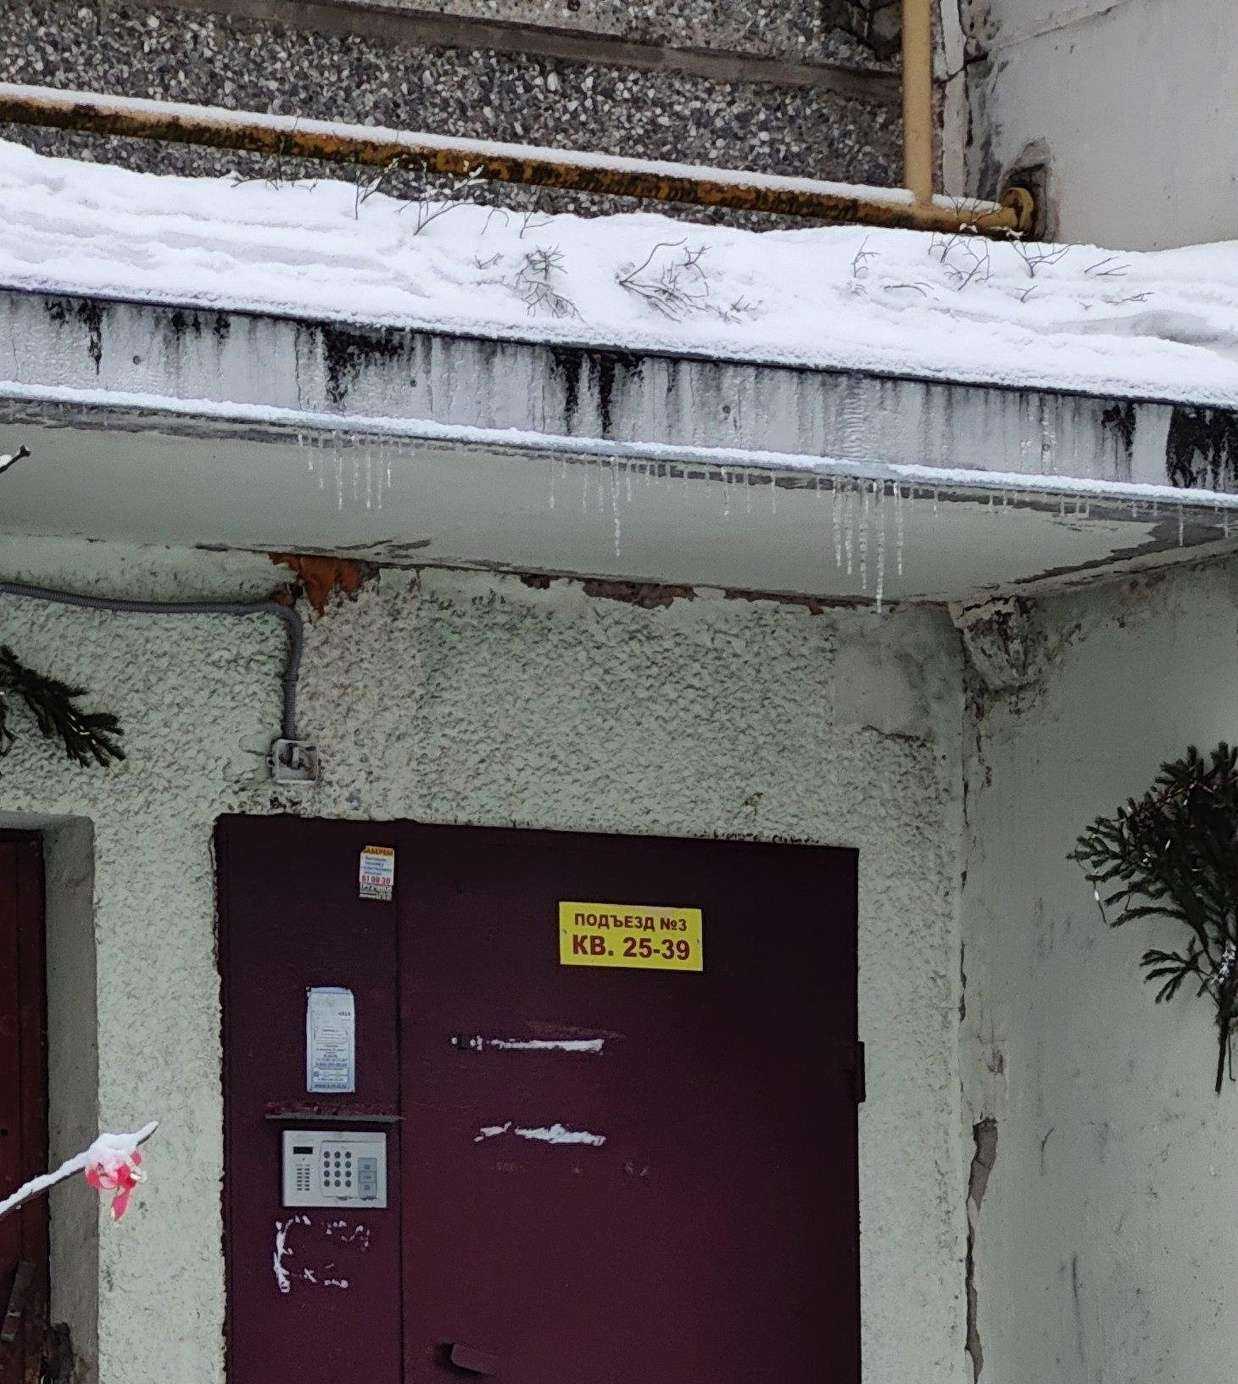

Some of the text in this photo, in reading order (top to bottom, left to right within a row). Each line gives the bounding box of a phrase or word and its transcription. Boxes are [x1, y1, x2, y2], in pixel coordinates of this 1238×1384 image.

[575, 913, 687, 932] ПОДЪЕЗД №3
[572, 934, 690, 960] КВ. 25-39
